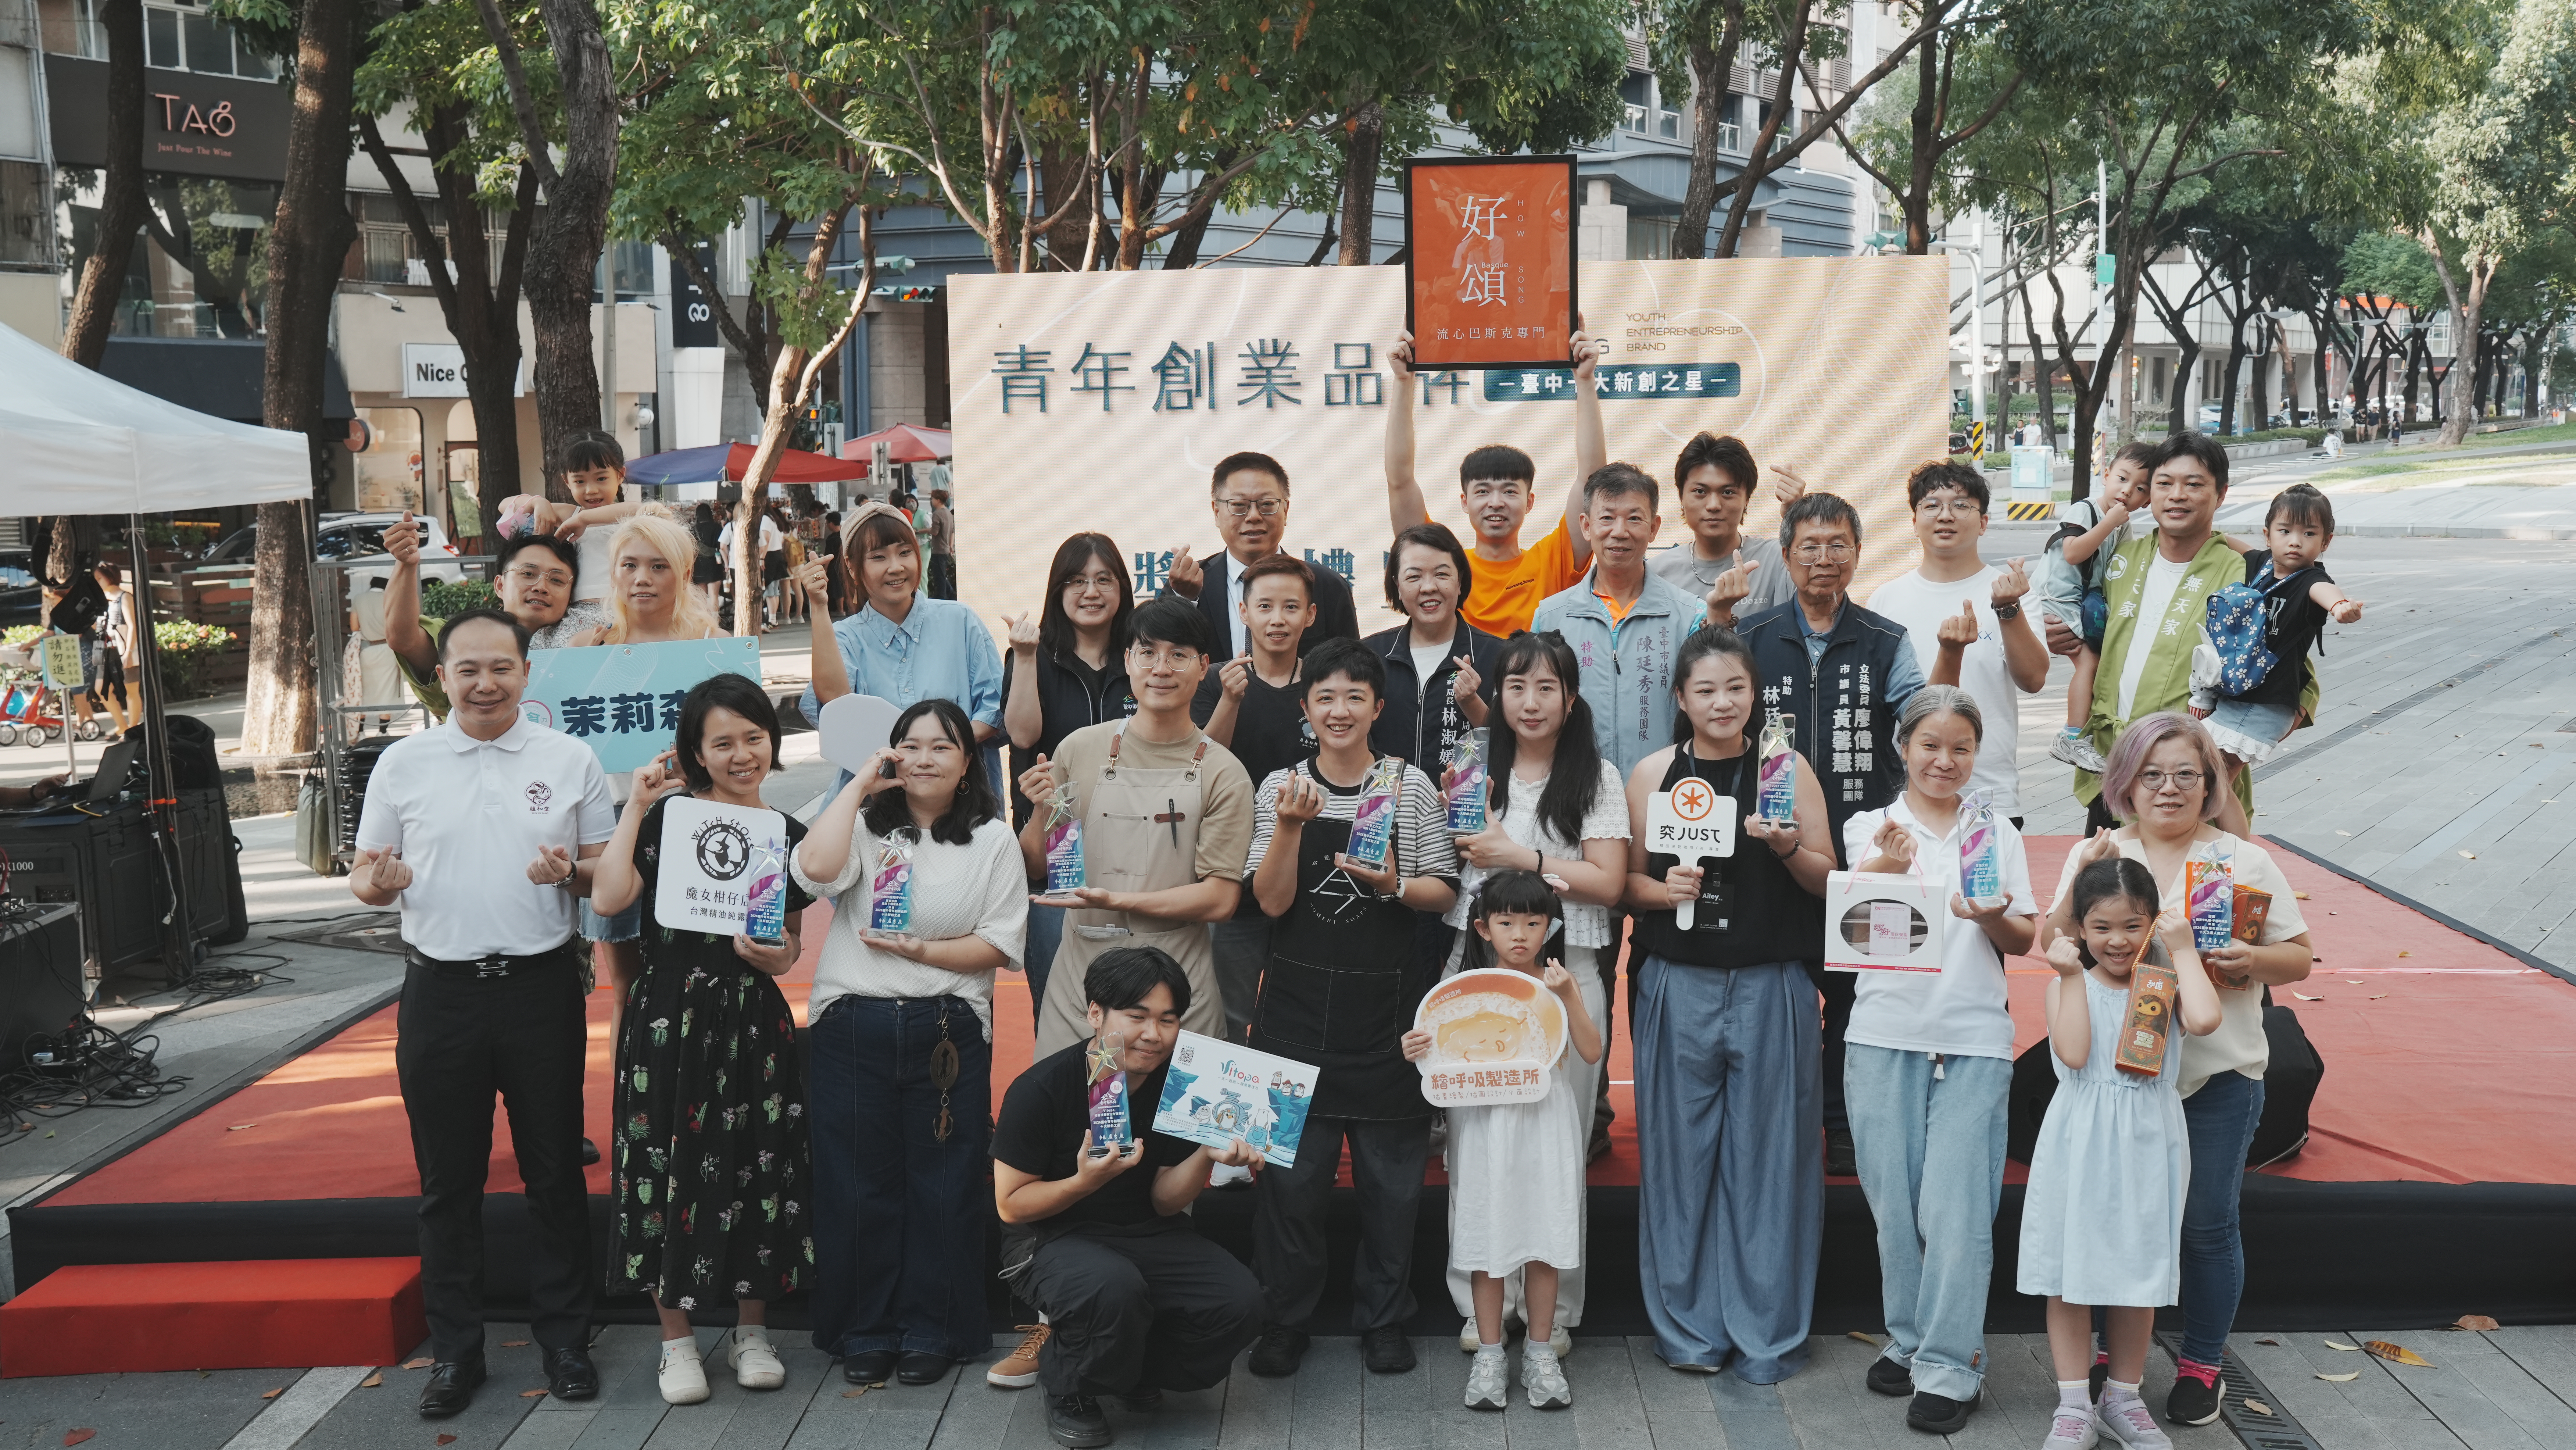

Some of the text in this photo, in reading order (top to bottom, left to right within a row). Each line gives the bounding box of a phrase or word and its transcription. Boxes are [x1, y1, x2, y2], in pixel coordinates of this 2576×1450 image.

[158, 142, 232, 157] Just Pour The Wine
[1516, 200, 1525, 237] HOW
[1437, 326, 1545, 340] 流心巴斯克專門
[1626, 326, 1743, 337] ENTREPRENEURSHIP
[1626, 343, 1666, 351] BRAND
[416, 363, 455, 382] Nice
[2161, 574, 2203, 635] 無天家
[1581, 640, 1593, 668] 特助
[1659, 626, 1670, 689] 臺中市議員
[1782, 676, 1793, 696] 特助
[1839, 664, 1850, 706] 市議員
[1859, 664, 1870, 706] 立法委員
[1446, 688, 1455, 705] 局長
[1439, 707, 1457, 765] 林淑媛
[1832, 708, 1853, 773] 黃馨慧
[1854, 708, 1873, 772] 廖偉翔
[1843, 778, 1864, 790] 服務
[1843, 790, 1864, 801] 團隊
[1660, 825, 1720, 843] 究 JUST
[1702, 893, 1719, 901] Ailey
[1428, 989, 1461, 1009] 繪呼吸製造所
[1220, 1060, 1259, 1083] Vitopa
[1431, 1068, 1539, 1090] 繪呼吸製造所
